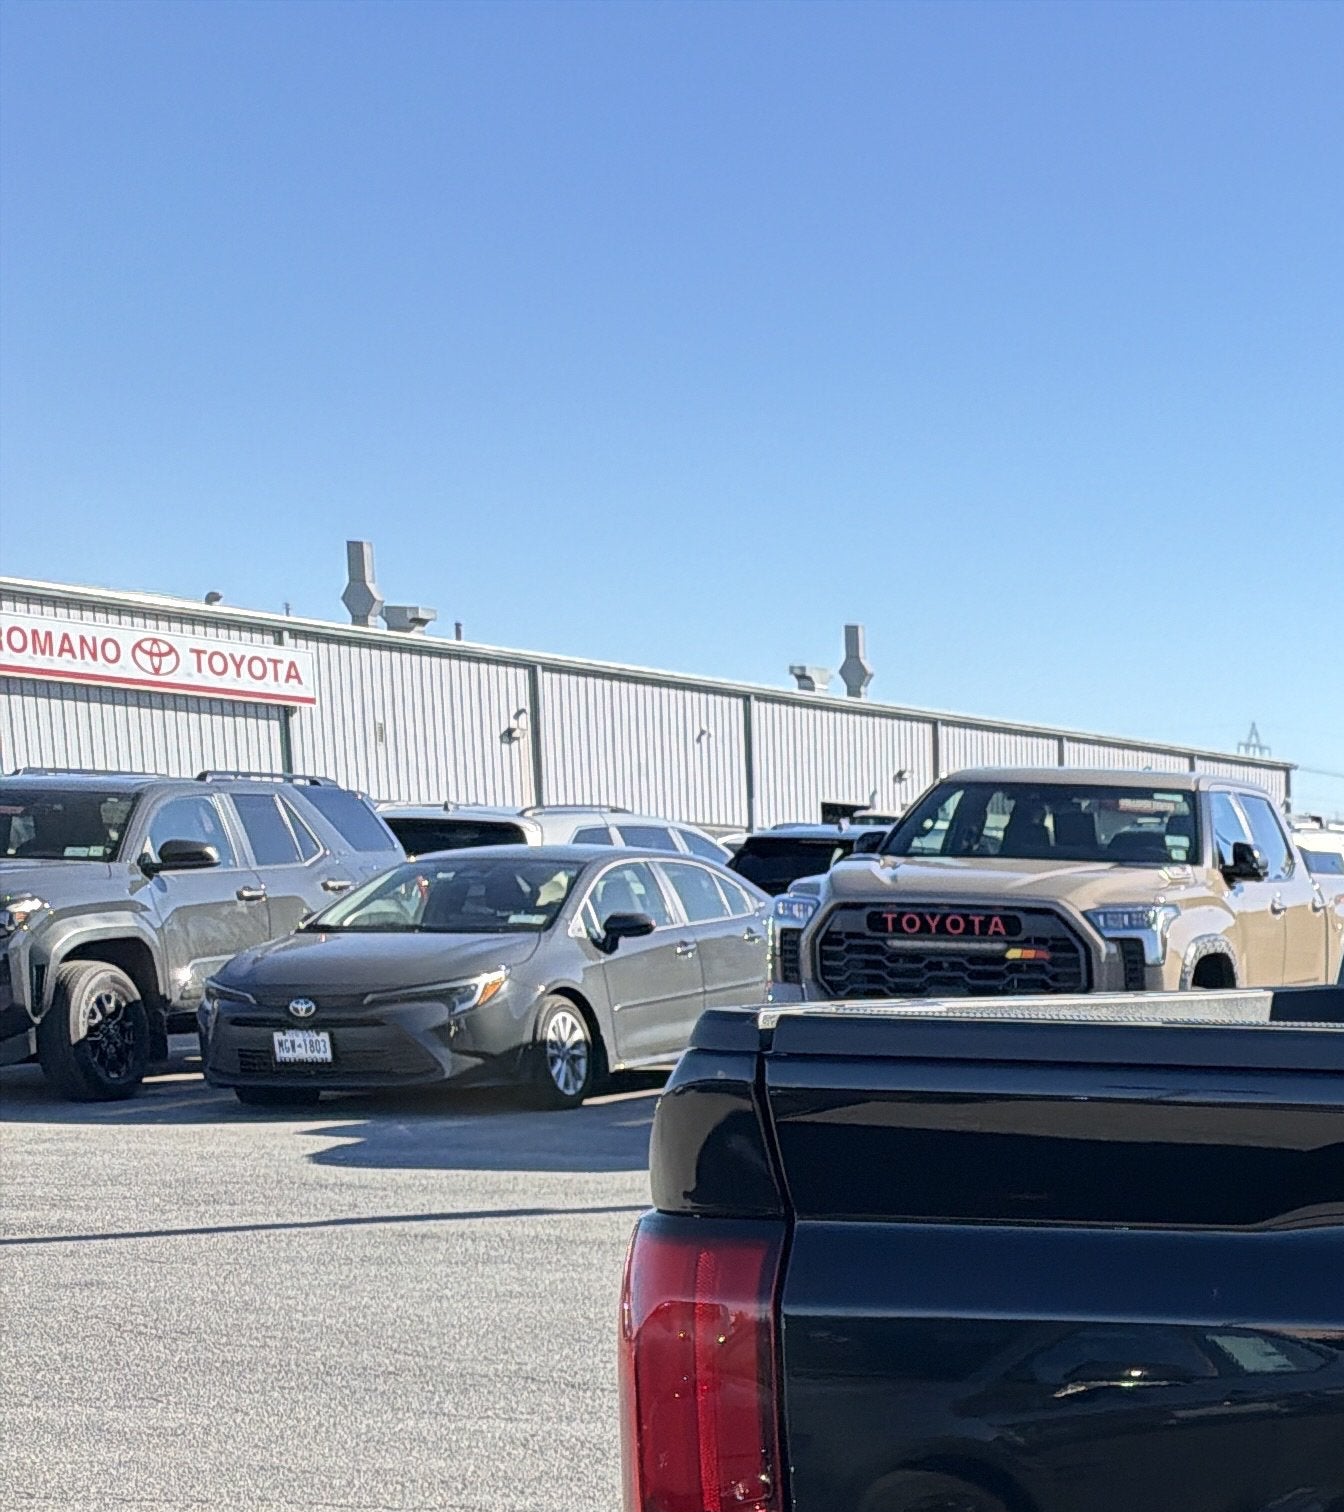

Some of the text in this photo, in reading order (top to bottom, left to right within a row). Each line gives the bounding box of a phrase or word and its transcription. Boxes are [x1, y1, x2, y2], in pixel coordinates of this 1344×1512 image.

[0, 625, 304, 686] OMANO TOYOTA
[882, 912, 1007, 936] TOYOTA
